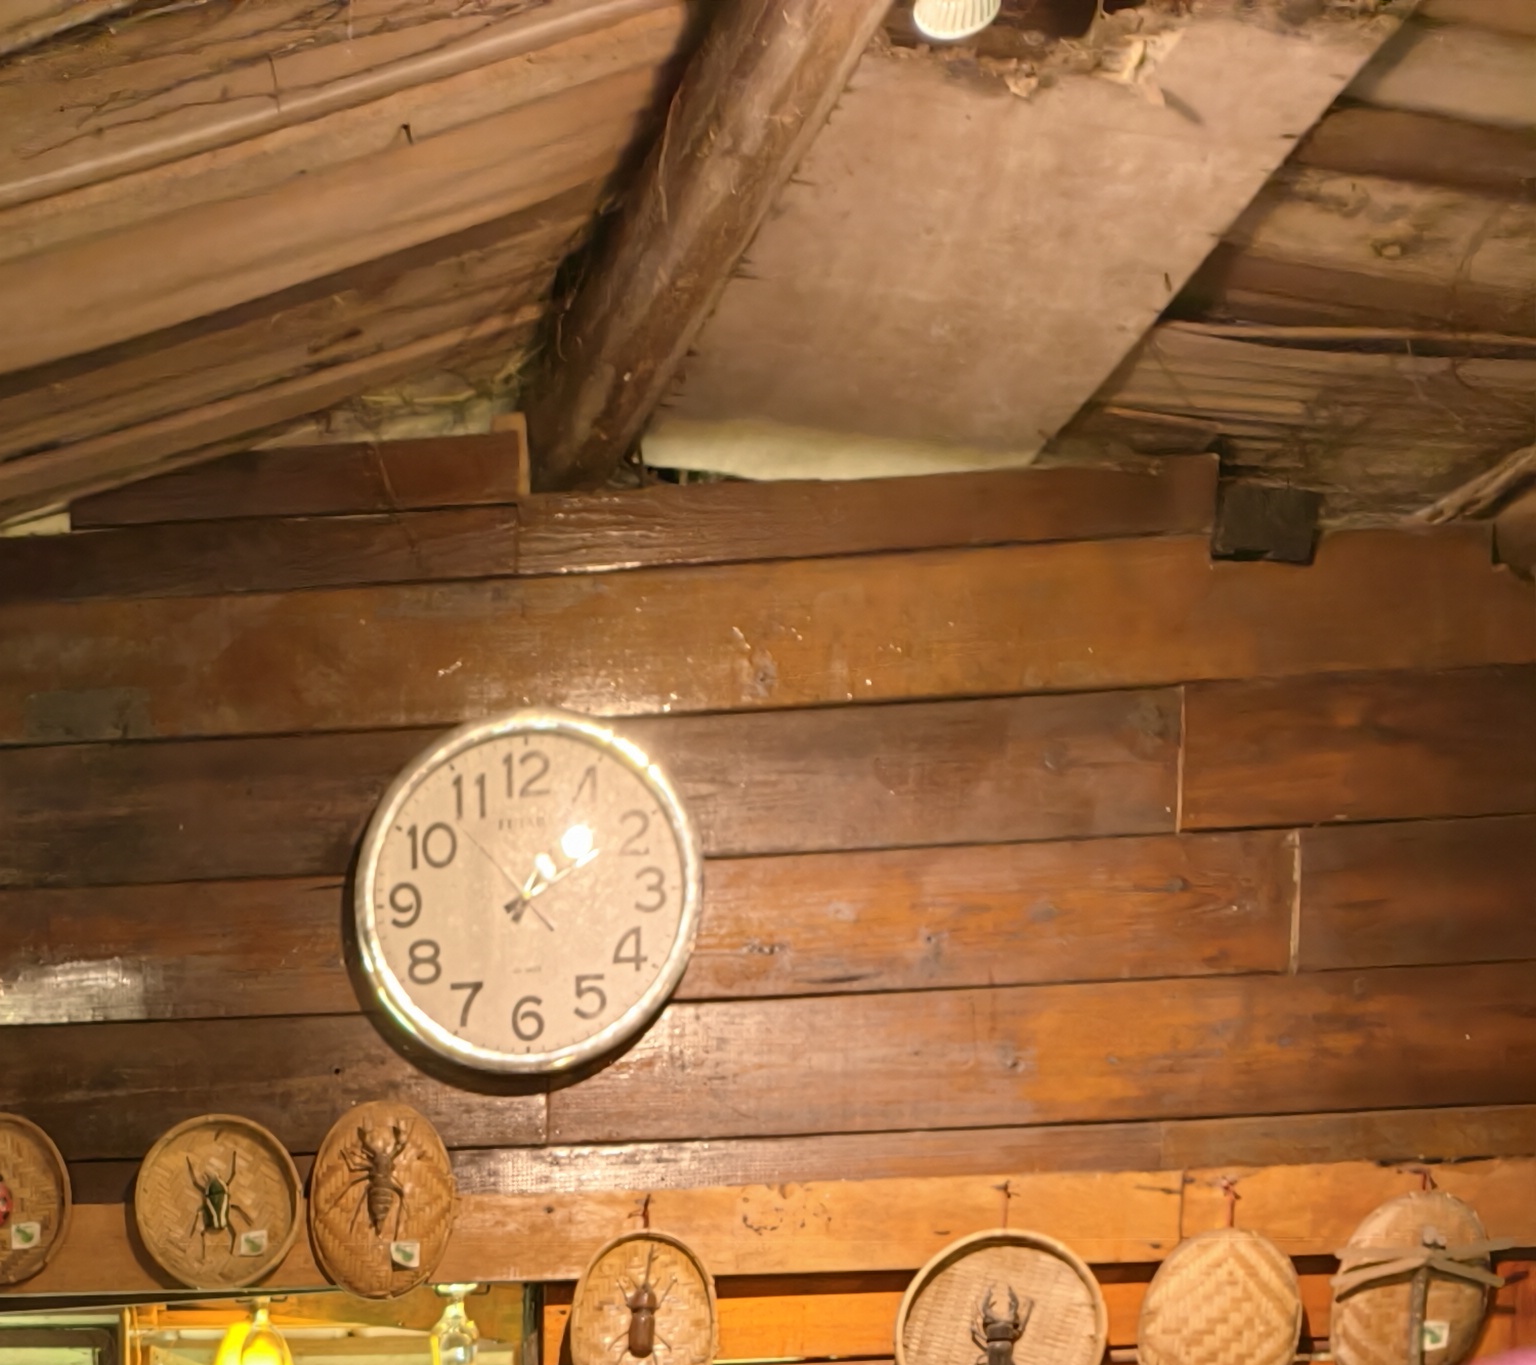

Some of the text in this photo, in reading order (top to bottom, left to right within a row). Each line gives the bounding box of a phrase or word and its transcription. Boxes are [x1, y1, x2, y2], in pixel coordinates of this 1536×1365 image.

[452, 773, 486, 820] 11
[502, 750, 551, 799] 12
[407, 822, 457, 870] 10
[619, 810, 650, 857] 2
[389, 883, 422, 928] 9
[634, 867, 666, 913] 3
[408, 939, 442, 985] 8
[613, 926, 648, 972] 4
[450, 981, 484, 1027] 7
[512, 995, 545, 1042] 6
[574, 974, 607, 1020] 5
